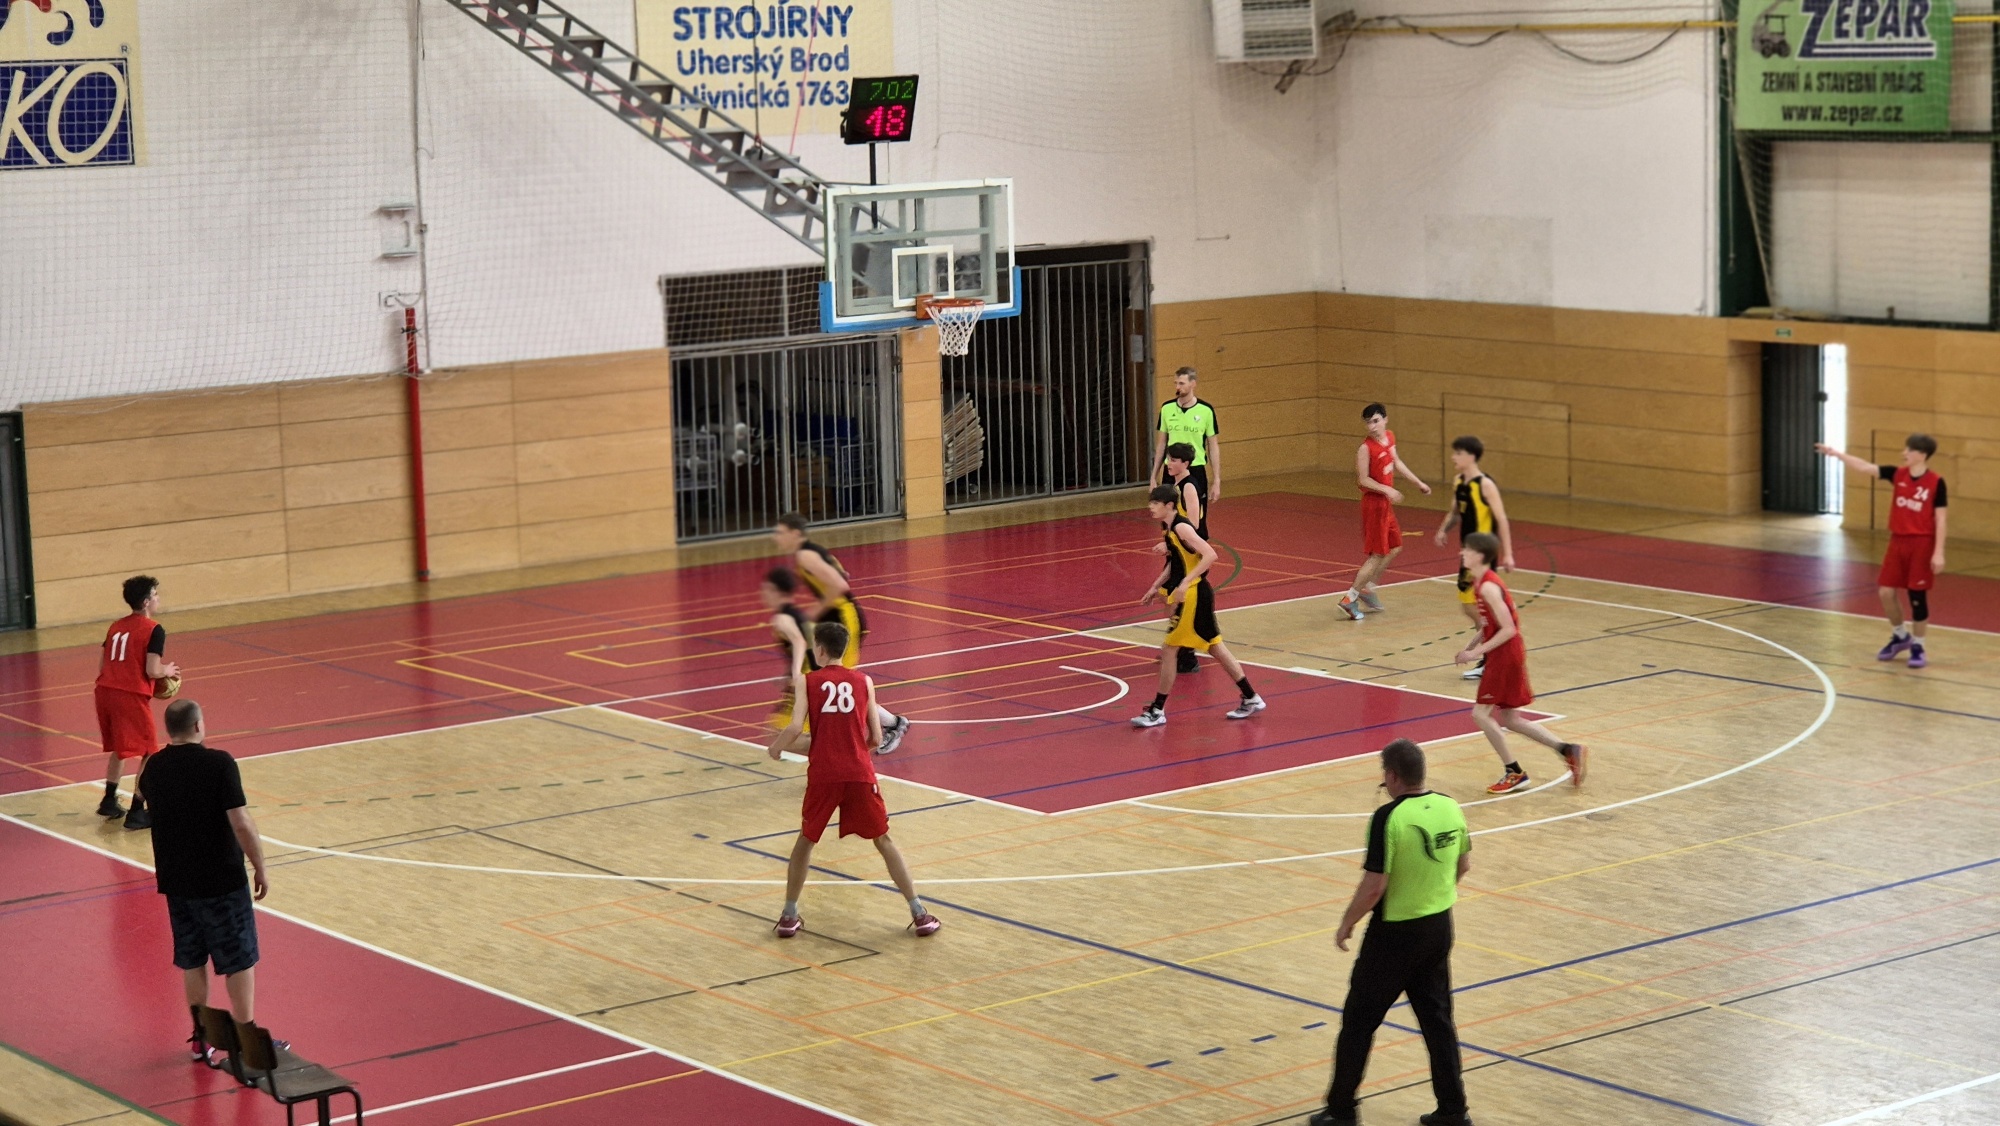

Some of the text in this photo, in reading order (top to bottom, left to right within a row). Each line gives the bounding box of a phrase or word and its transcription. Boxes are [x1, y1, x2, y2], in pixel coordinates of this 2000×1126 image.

[672, 0, 854, 41] STROJÍRNY
[1797, 0, 1931, 58] ZEPAR
[677, 44, 850, 80] Uherský Brod
[796, 80, 850, 107] 1763
[869, 80, 914, 101] 7.02
[1761, 64, 1925, 93] ZEMNÍ A STAVEBNÍ PRÁCE
[865, 105, 906, 137] 18
[1781, 104, 1904, 126] www.zepar.cz
[1913, 486, 1929, 502] 24
[110, 631, 130, 662] 11
[820, 680, 855, 714] 28
